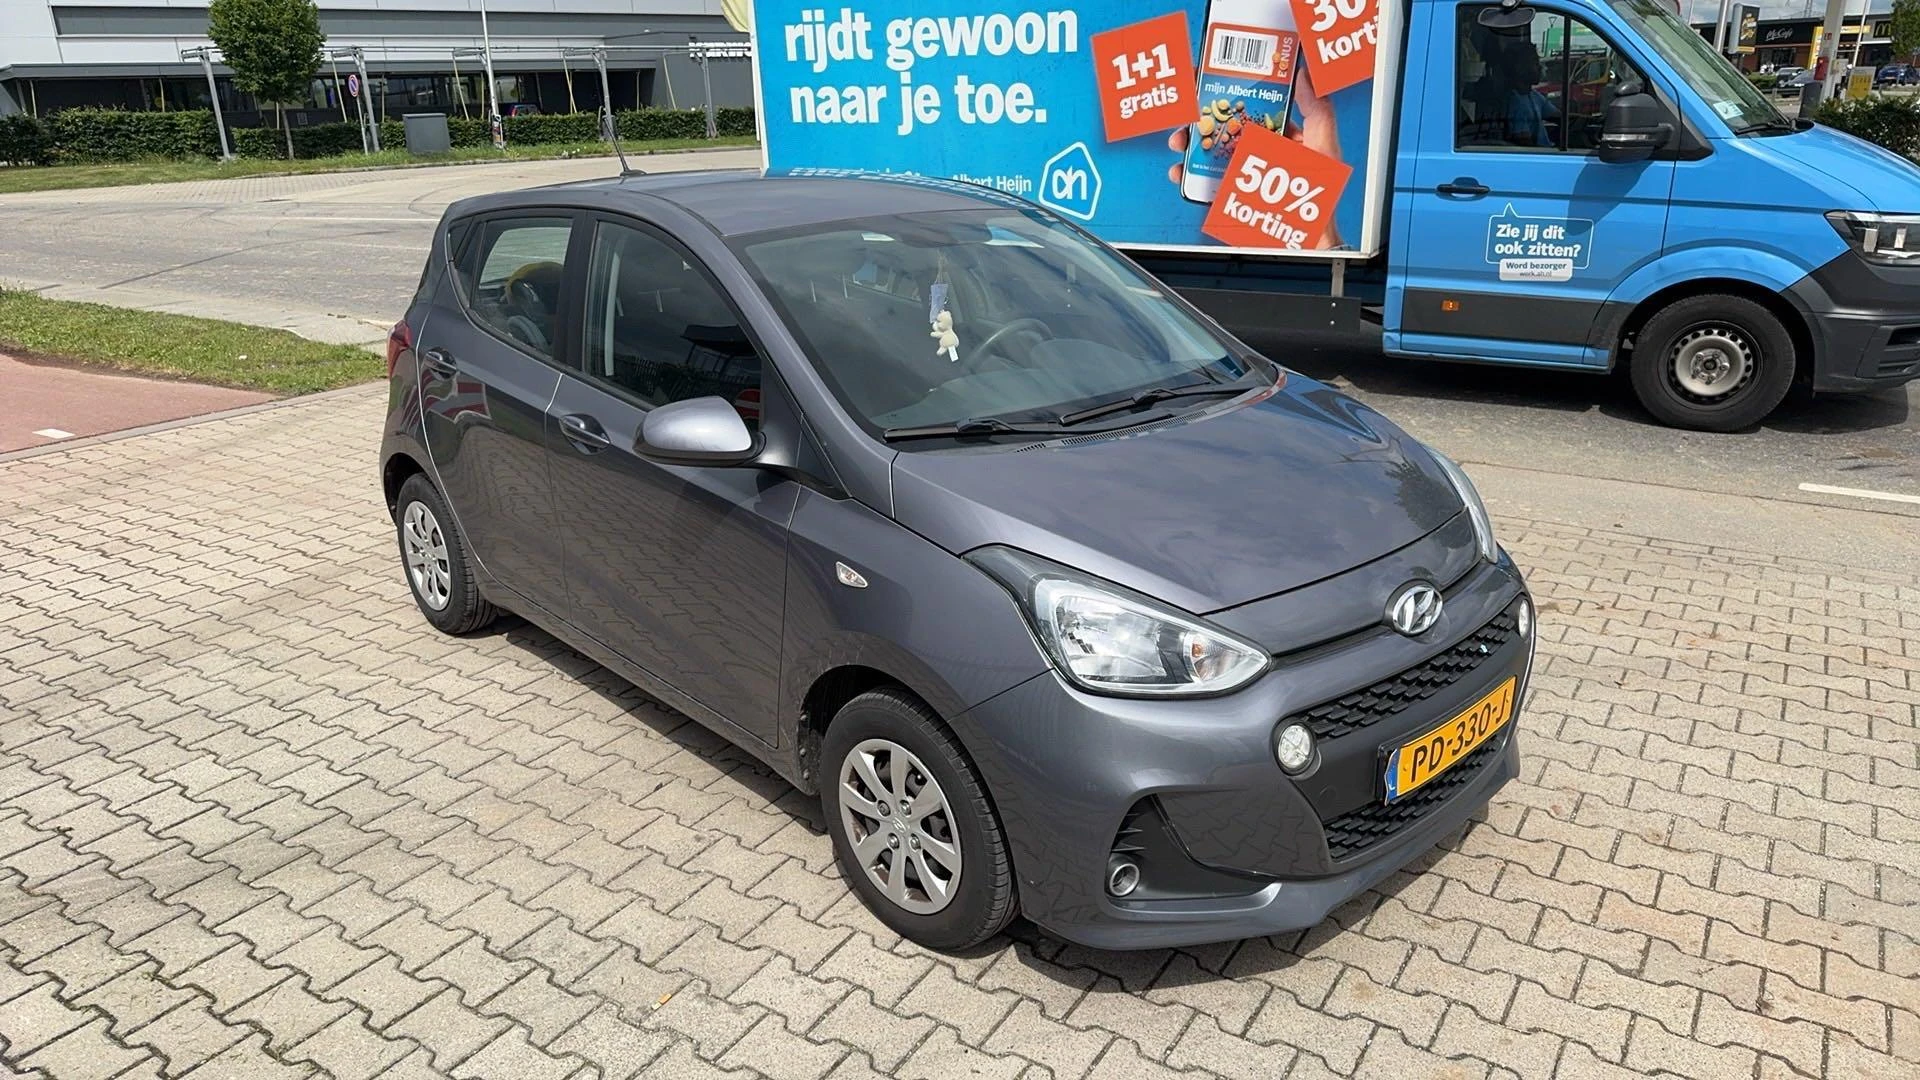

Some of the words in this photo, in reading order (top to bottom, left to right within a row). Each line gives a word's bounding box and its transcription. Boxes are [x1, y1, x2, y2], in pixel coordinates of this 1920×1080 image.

[1304, 0, 1379, 31] 30
[784, 8, 873, 73] rijdt
[886, 9, 1078, 71] gewoon
[1112, 43, 1176, 90] 1+1
[790, 84, 887, 123] naar
[897, 71, 941, 136] je
[954, 75, 1047, 124] toe.
[1120, 83, 1178, 119] gratis
[1205, 83, 1226, 95] mijn
[1227, 85, 1258, 98] Albert
[1259, 89, 1283, 103] Heijn
[996, 175, 1032, 195] Heijn
[1235, 154, 1325, 222] 50%
[1223, 192, 1308, 249] korting
[1496, 224, 1520, 238] Zie
[1522, 224, 1539, 241] jij
[1542, 225, 1565, 239] dit
[1494, 241, 1524, 255] ook
[1527, 242, 1581, 257] zitten?
[1530, 262, 1567, 271] bezorger
[1411, 689, 1507, 783] PD-330-J
